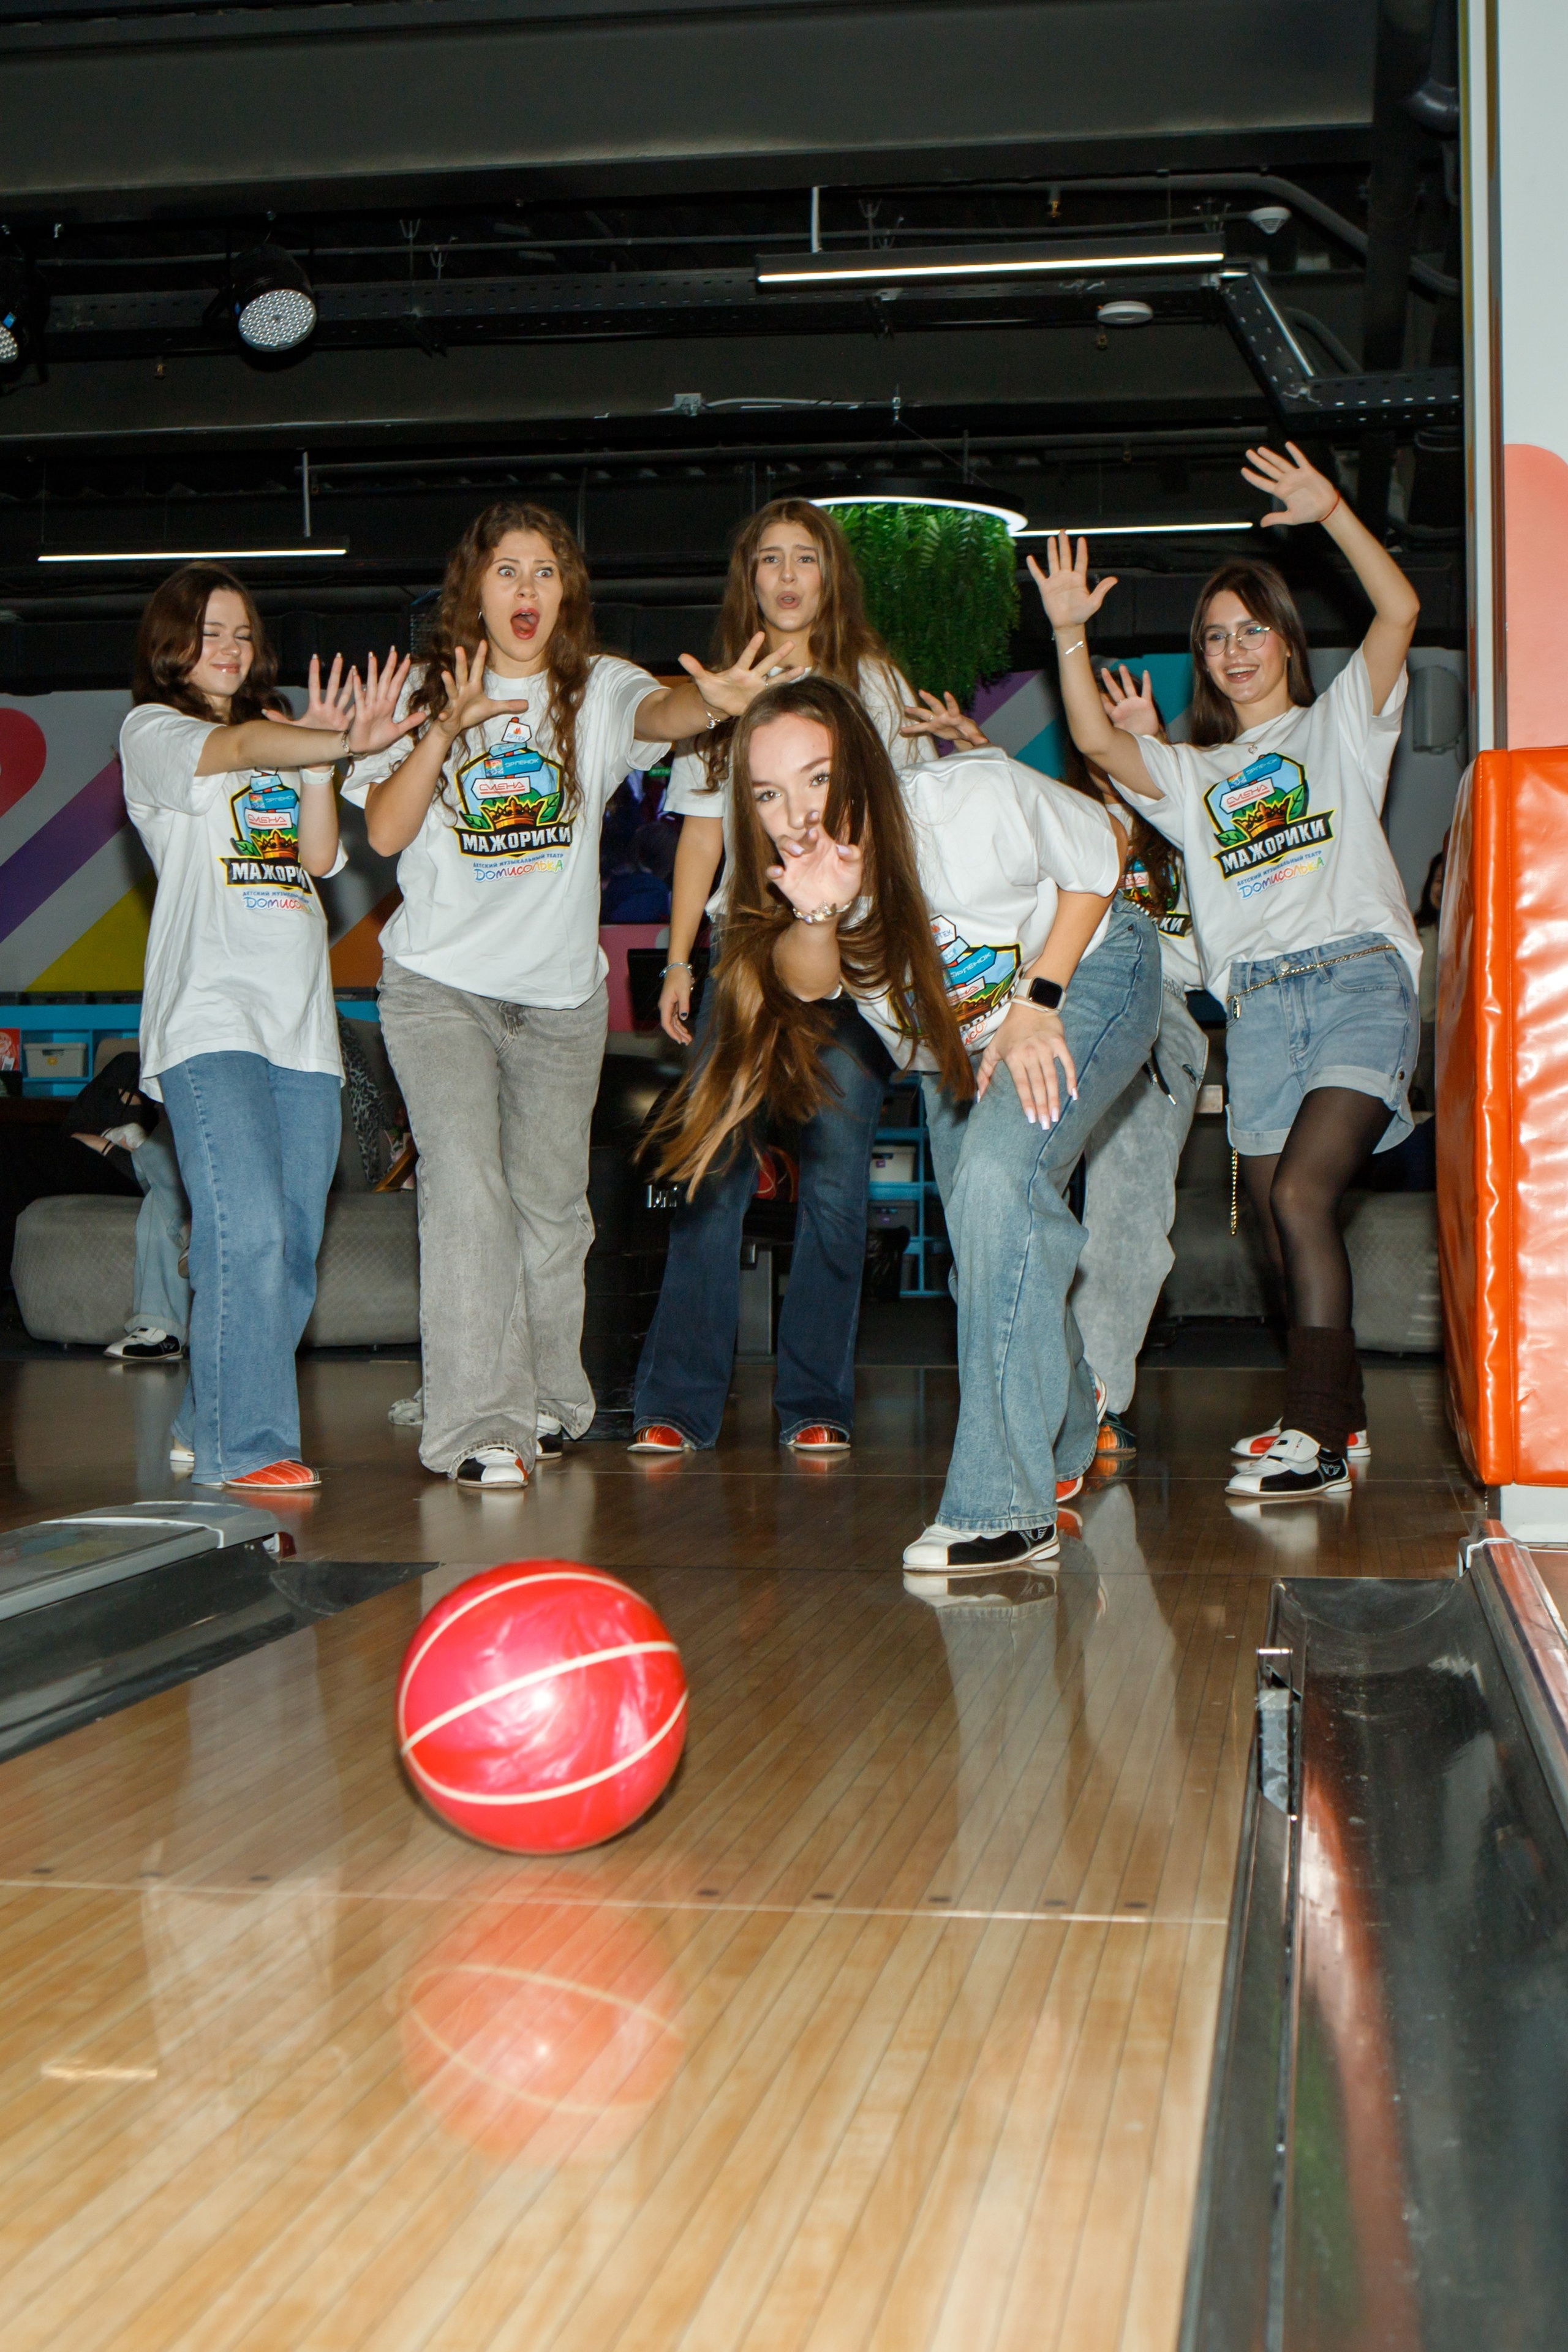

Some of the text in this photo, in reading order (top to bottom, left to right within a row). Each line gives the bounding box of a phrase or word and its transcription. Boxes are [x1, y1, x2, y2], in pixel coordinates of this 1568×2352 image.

[461, 826, 571, 852] МАЖОРИКИ
[1221, 819, 1326, 873] МАЖОРИКИ
[499, 854, 545, 867] МУЗЫКАЛЬНЫЙ
[1237, 850, 1322, 886] ДЕТСКИЙ МУЗЫКАЛЬНЫЙ ТЕАТР
[231, 862, 307, 889] МАЖОРИ
[933, 929, 953, 938] РТЕК
